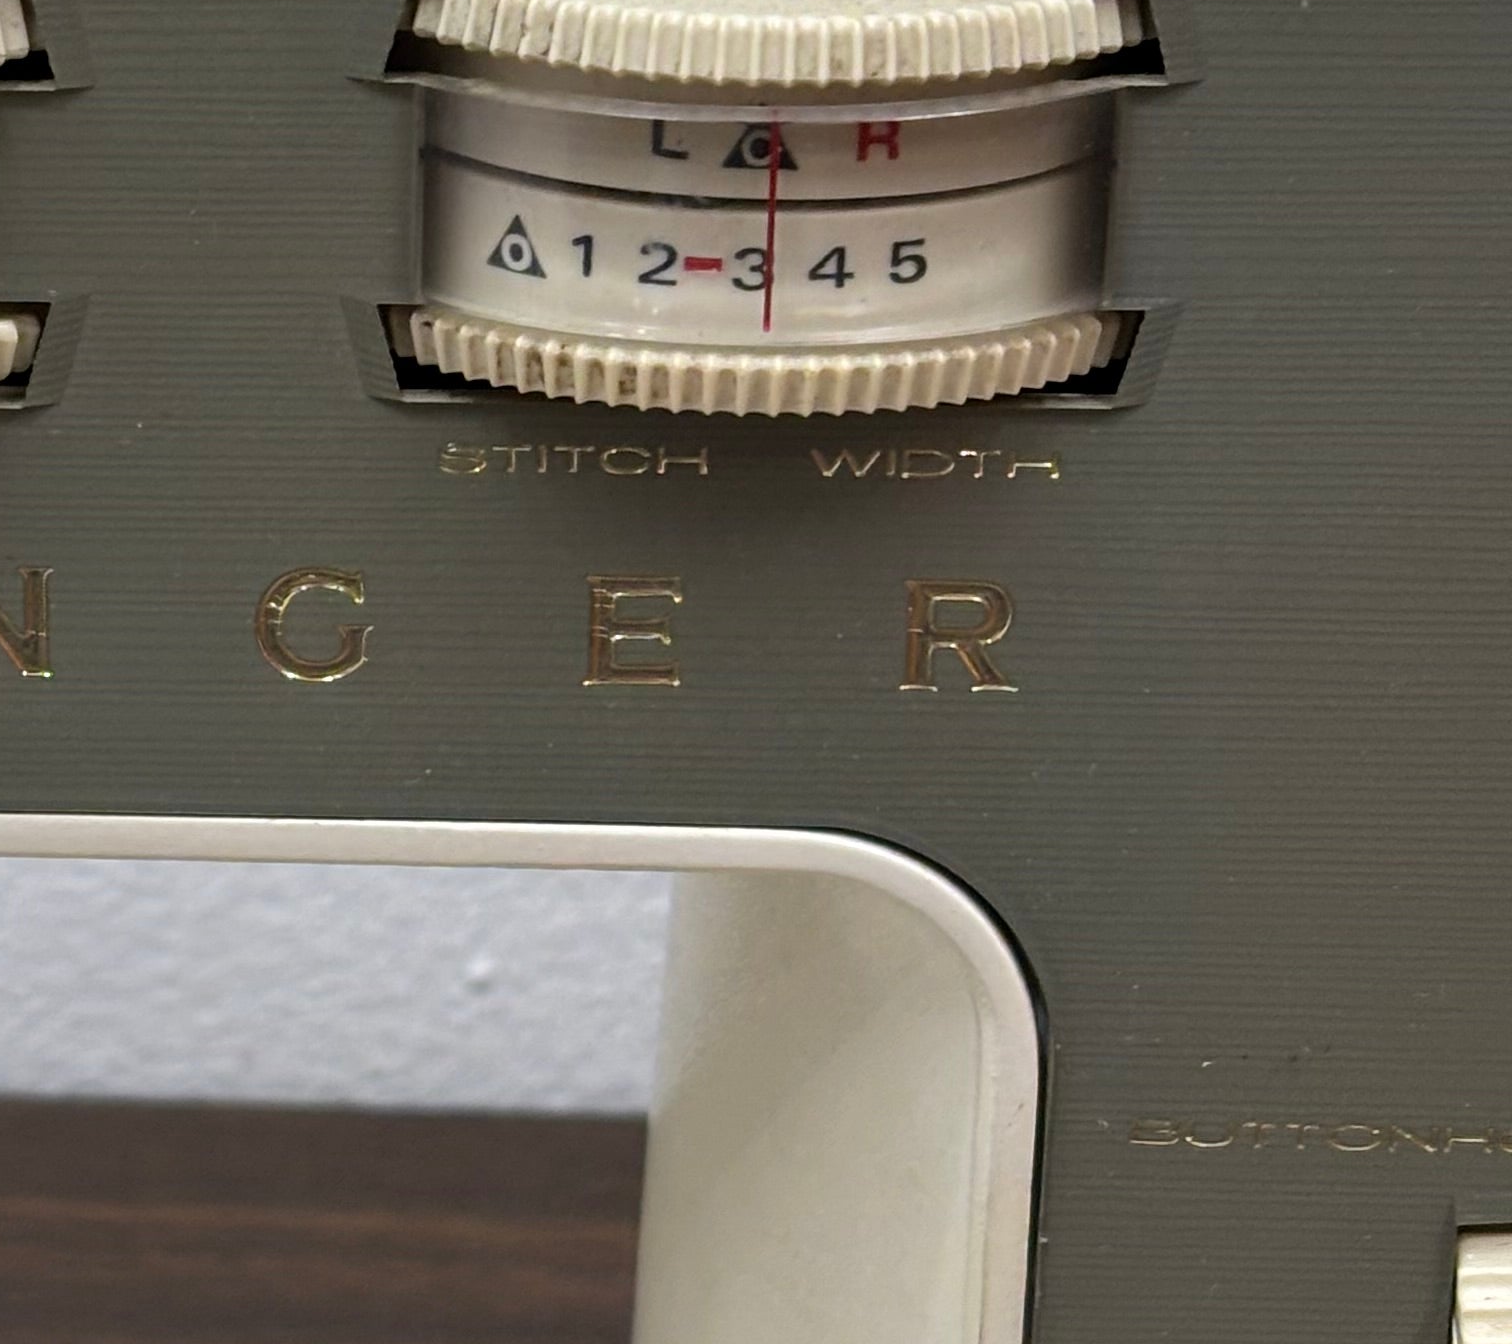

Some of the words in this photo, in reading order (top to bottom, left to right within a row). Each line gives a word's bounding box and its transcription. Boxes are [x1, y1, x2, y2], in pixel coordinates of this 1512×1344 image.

[651, 120, 689, 161] L
[571, 235, 594, 278] 1
[808, 246, 855, 289] 4
[889, 238, 928, 284] 5
[439, 443, 709, 477] STITCH
[810, 447, 1062, 480] WIDTH
